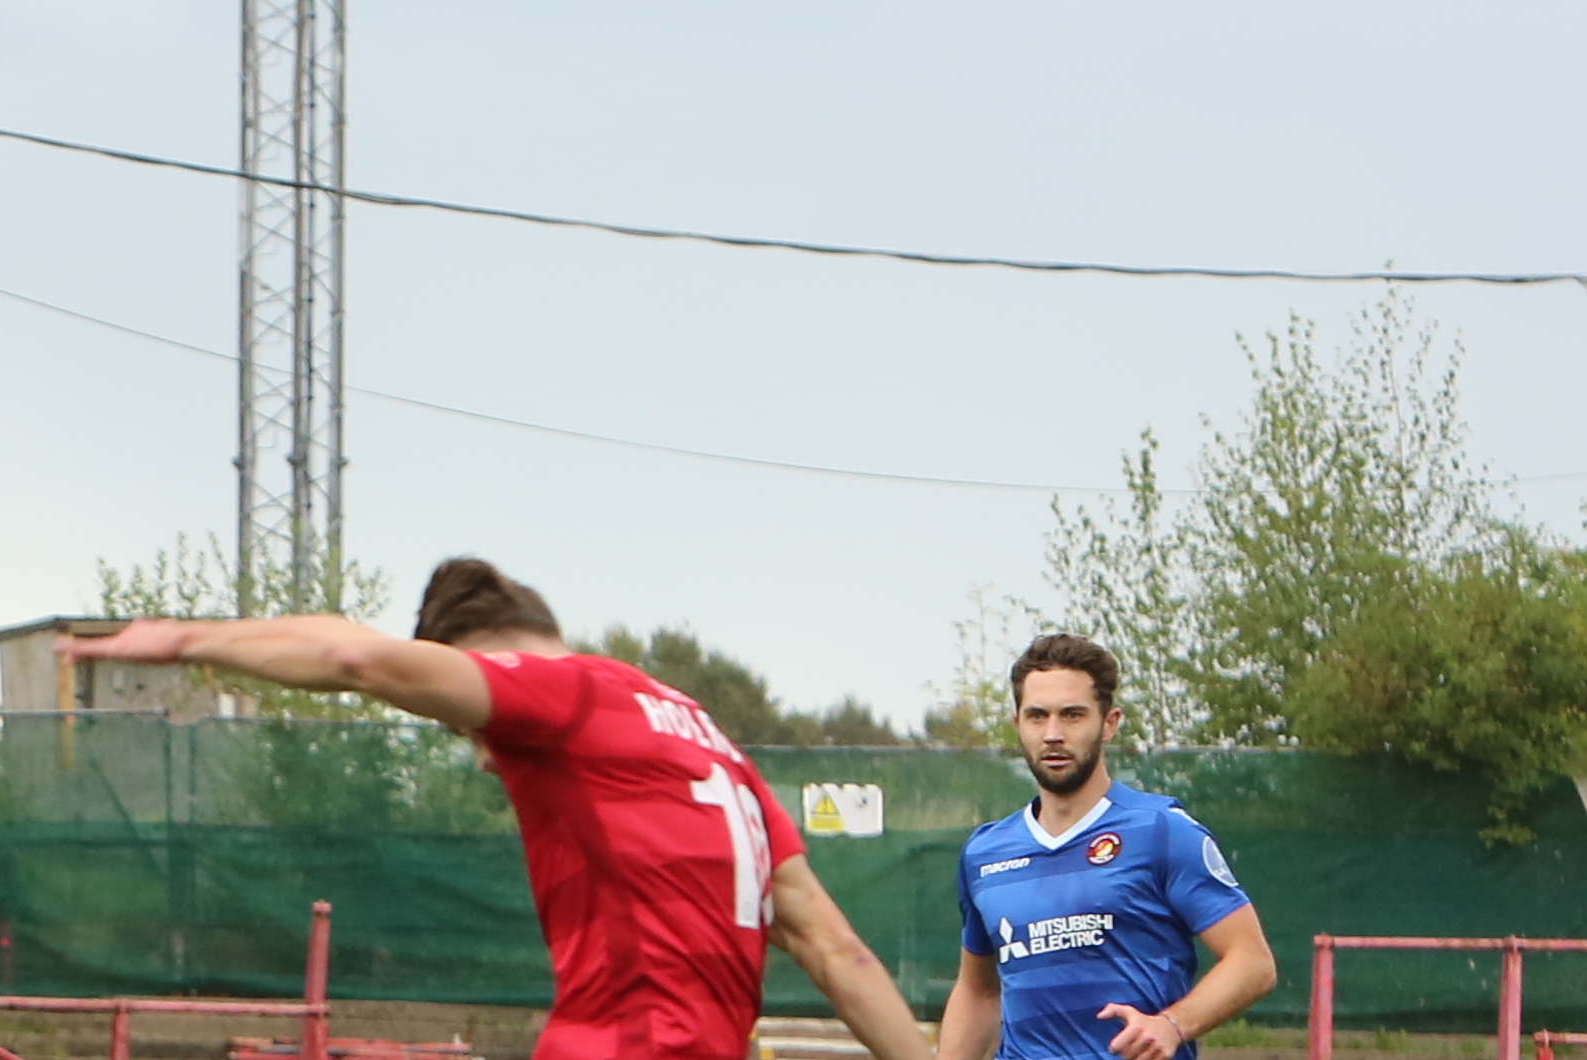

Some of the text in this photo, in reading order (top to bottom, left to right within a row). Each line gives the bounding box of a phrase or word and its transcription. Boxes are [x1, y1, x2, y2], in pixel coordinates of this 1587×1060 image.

[980, 857, 1030, 877] macron
[1027, 914, 1113, 939] MITSUBISHI
[1029, 930, 1105, 955] ELECTRIC
